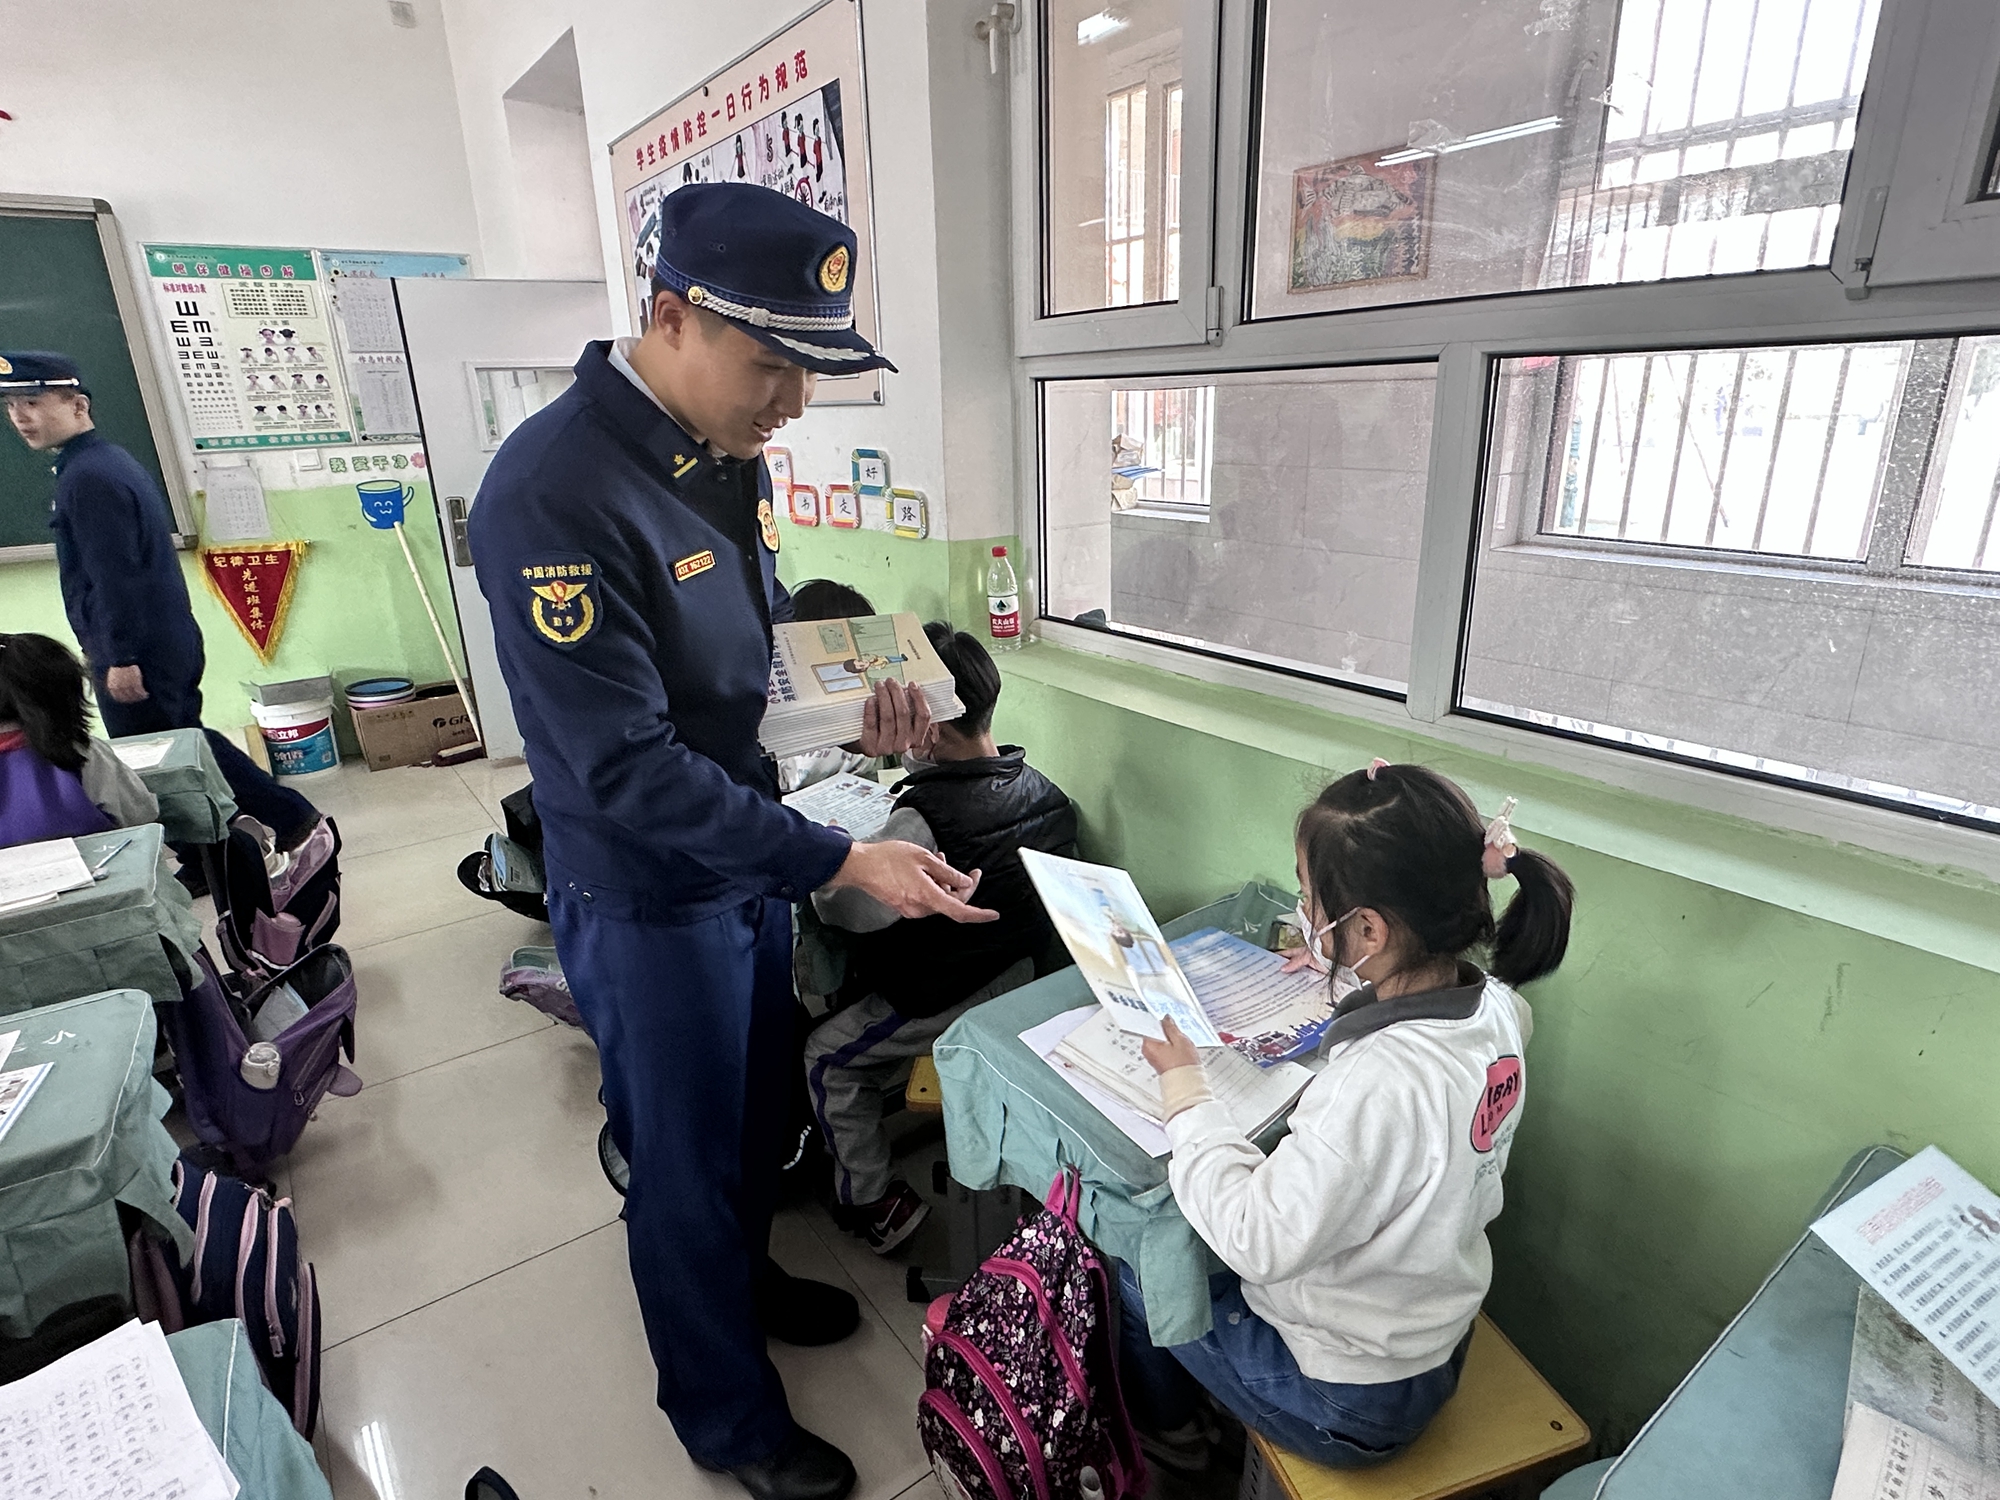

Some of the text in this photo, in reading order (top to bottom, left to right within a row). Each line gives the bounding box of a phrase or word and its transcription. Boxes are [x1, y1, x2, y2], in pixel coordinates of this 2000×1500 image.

[636, 49, 808, 171] 学生疫情防控一日行为规范
[329, 454, 409, 474] 我爱干净
[213, 554, 280, 568] 纪律卫生
[522, 563, 593, 580] 中国消防救援
[241, 568, 266, 630] 先进班集体
[278, 728, 299, 740] 立邦
